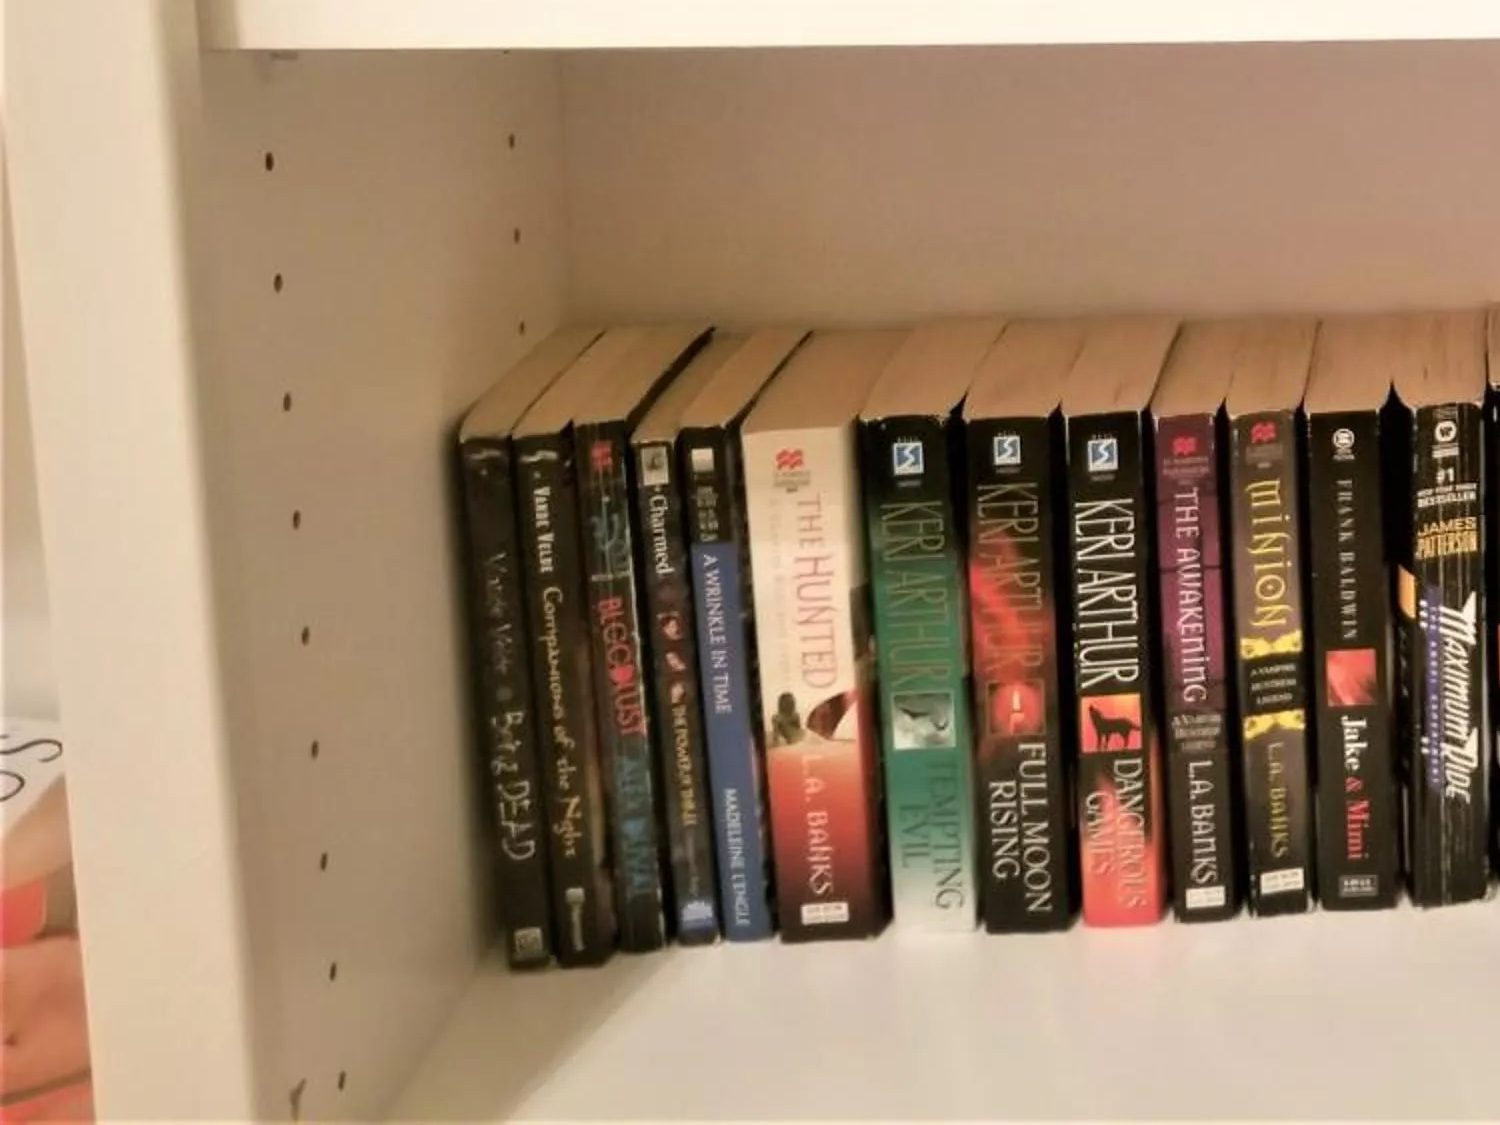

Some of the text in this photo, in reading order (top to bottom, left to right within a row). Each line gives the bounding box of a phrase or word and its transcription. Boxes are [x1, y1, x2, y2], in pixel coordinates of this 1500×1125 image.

[650, 492, 675, 575] Charmed
[880, 502, 945, 562] KERI
[977, 482, 1039, 543] KERI
[1174, 487, 1200, 539] THE
[1337, 478, 1355, 542] FRANK
[1417, 516, 1477, 536] JAMES
[703, 553, 718, 567] A
[794, 492, 838, 689] THE HUNTED
[1075, 498, 1139, 689] KERI ARTHUR
[1339, 552, 1357, 639] BALDWIN
[704, 569, 727, 645] WRINKLE
[538, 586, 565, 720] Companions
[710, 650, 729, 670] IN
[712, 673, 732, 714] TIME
[1188, 760, 1214, 800] L.A.
[1341, 715, 1368, 772] Jake
[498, 780, 536, 860] DEAD
[1345, 777, 1364, 792] &
[807, 811, 833, 894] BANKS
[930, 760, 964, 909] TEMPTING
[988, 780, 1020, 879] RISING
[1017, 742, 1053, 912] FULL MOON
[1113, 757, 1148, 909] DANGEROUS
[1191, 804, 1218, 884] BANKS
[1346, 799, 1371, 860] Mimi
